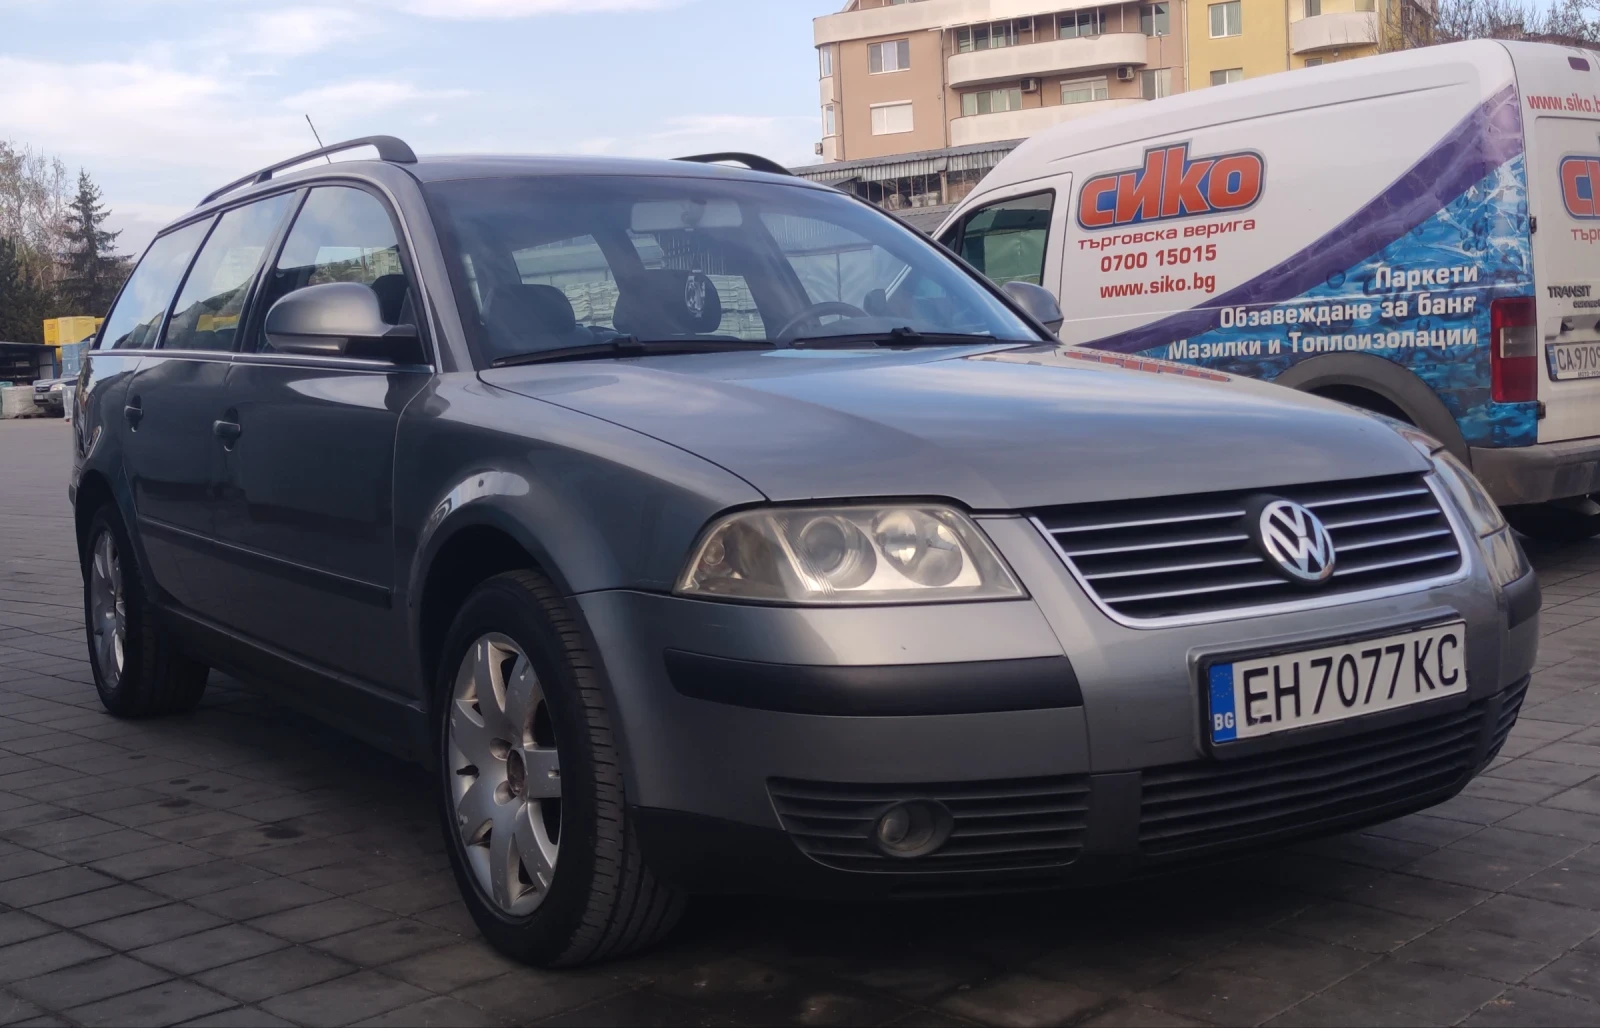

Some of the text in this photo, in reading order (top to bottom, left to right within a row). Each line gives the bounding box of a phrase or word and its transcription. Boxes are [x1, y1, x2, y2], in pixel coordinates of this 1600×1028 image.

[1078, 219, 1256, 251] търговска верига
[1100, 244, 1217, 272] 0700 15015
[1100, 272, 1216, 298] www.siko.bg
[1375, 265, 1478, 293] Паркети
[1547, 285, 1591, 298] TRANSIT
[1220, 293, 1477, 326] Обзавеждане за баня
[1168, 327, 1477, 360] Мазилки и Топлоизолации
[1214, 711, 1235, 731] BG
